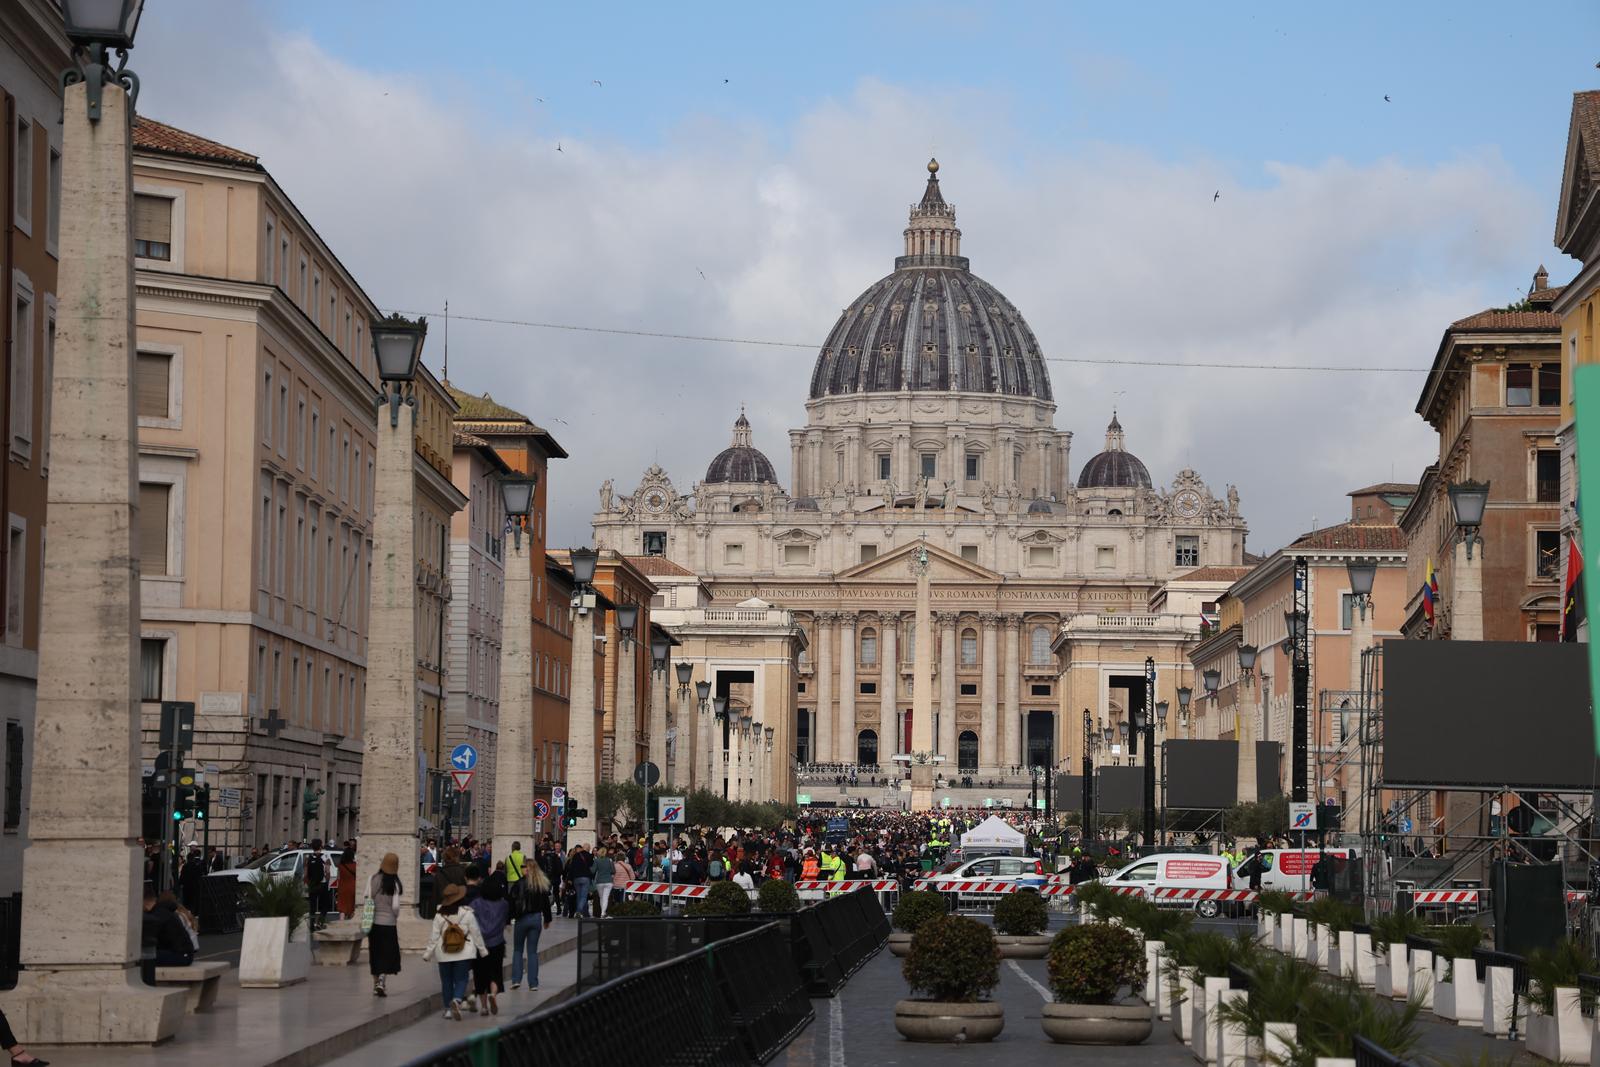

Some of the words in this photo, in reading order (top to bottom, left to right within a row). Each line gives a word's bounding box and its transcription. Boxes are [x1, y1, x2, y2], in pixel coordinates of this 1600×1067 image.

[760, 589, 809, 598] PRINCIPIS
[842, 589, 874, 598] PAVLVS
[947, 590, 996, 599] ROMANVS
[999, 591, 1024, 600] PONT
[1024, 591, 1045, 600] MAX
[1104, 592, 1130, 600] PONT
